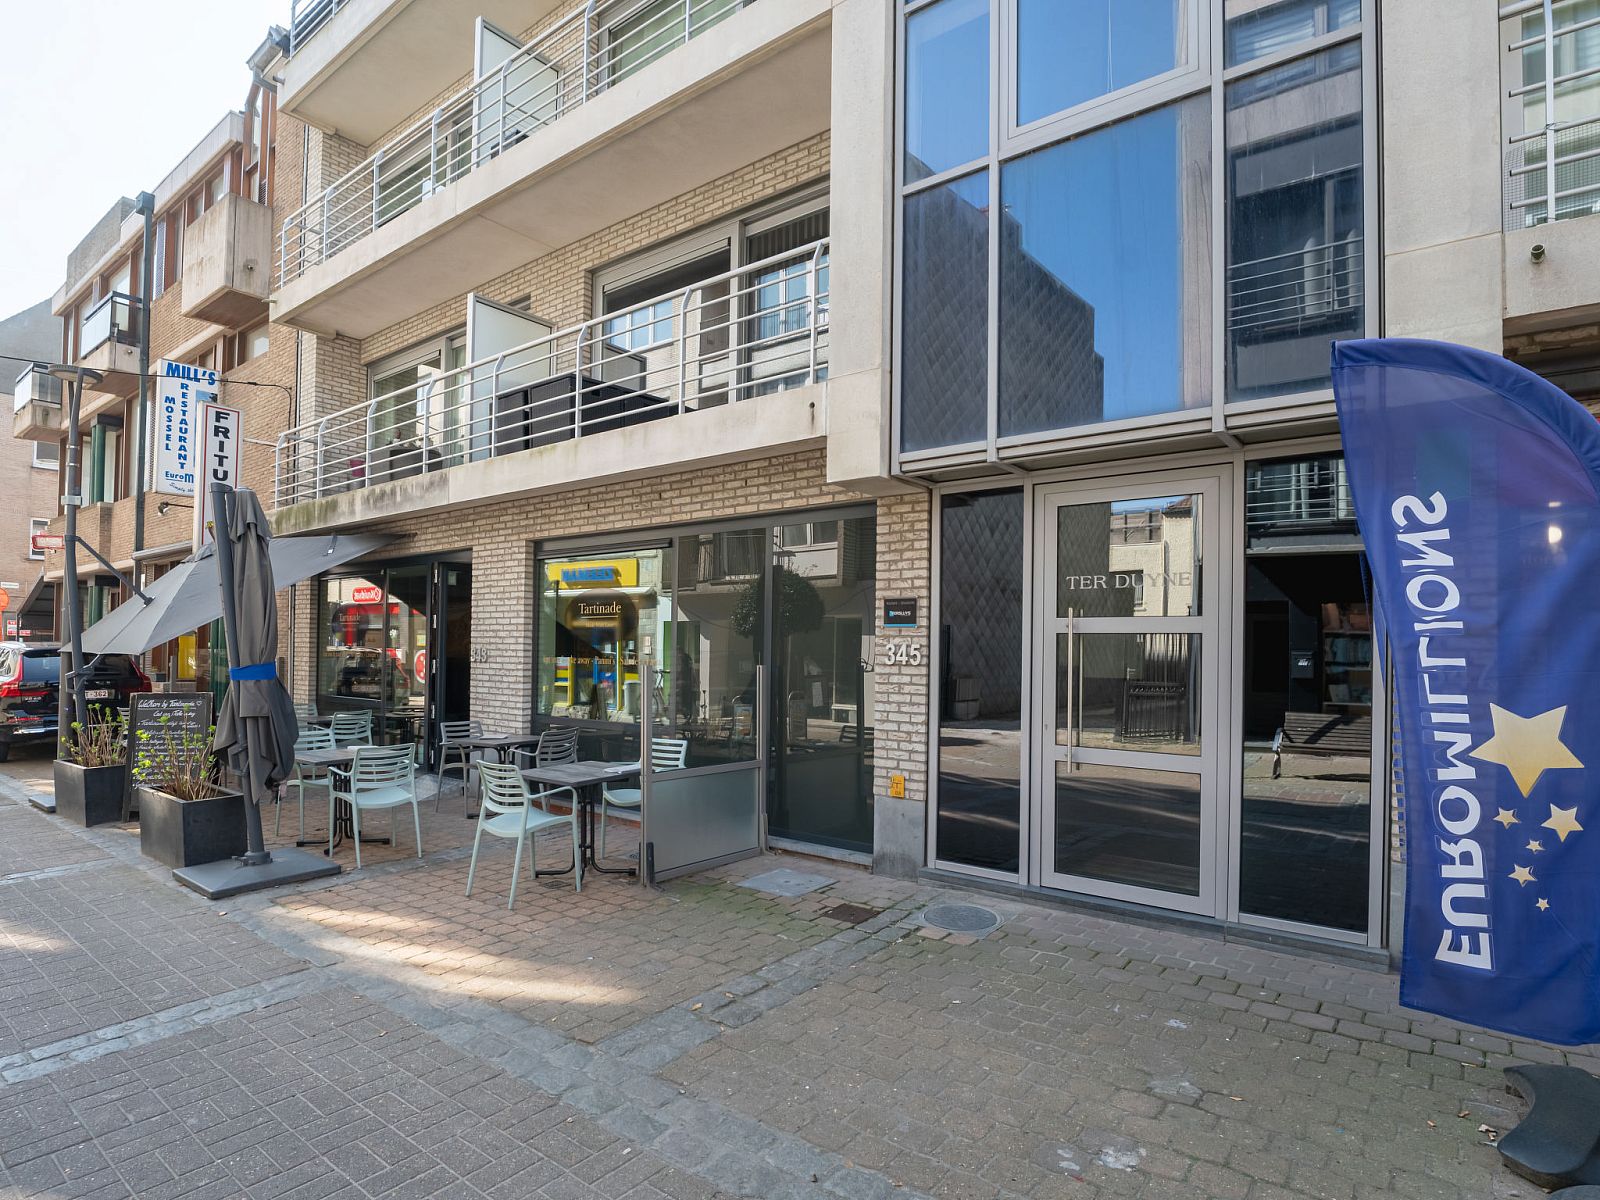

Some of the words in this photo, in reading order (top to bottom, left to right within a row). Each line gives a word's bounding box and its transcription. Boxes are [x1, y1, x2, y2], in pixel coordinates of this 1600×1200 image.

[165, 361, 216, 386] MILL'S
[164, 395, 176, 451] MOSSEL
[178, 382, 189, 470] RESTAURANT
[212, 410, 230, 482] FRITU
[1065, 575, 1108, 590] TER
[1115, 571, 1192, 589] DUYNE
[578, 601, 622, 615] Tartinade
[884, 643, 921, 666] 345
